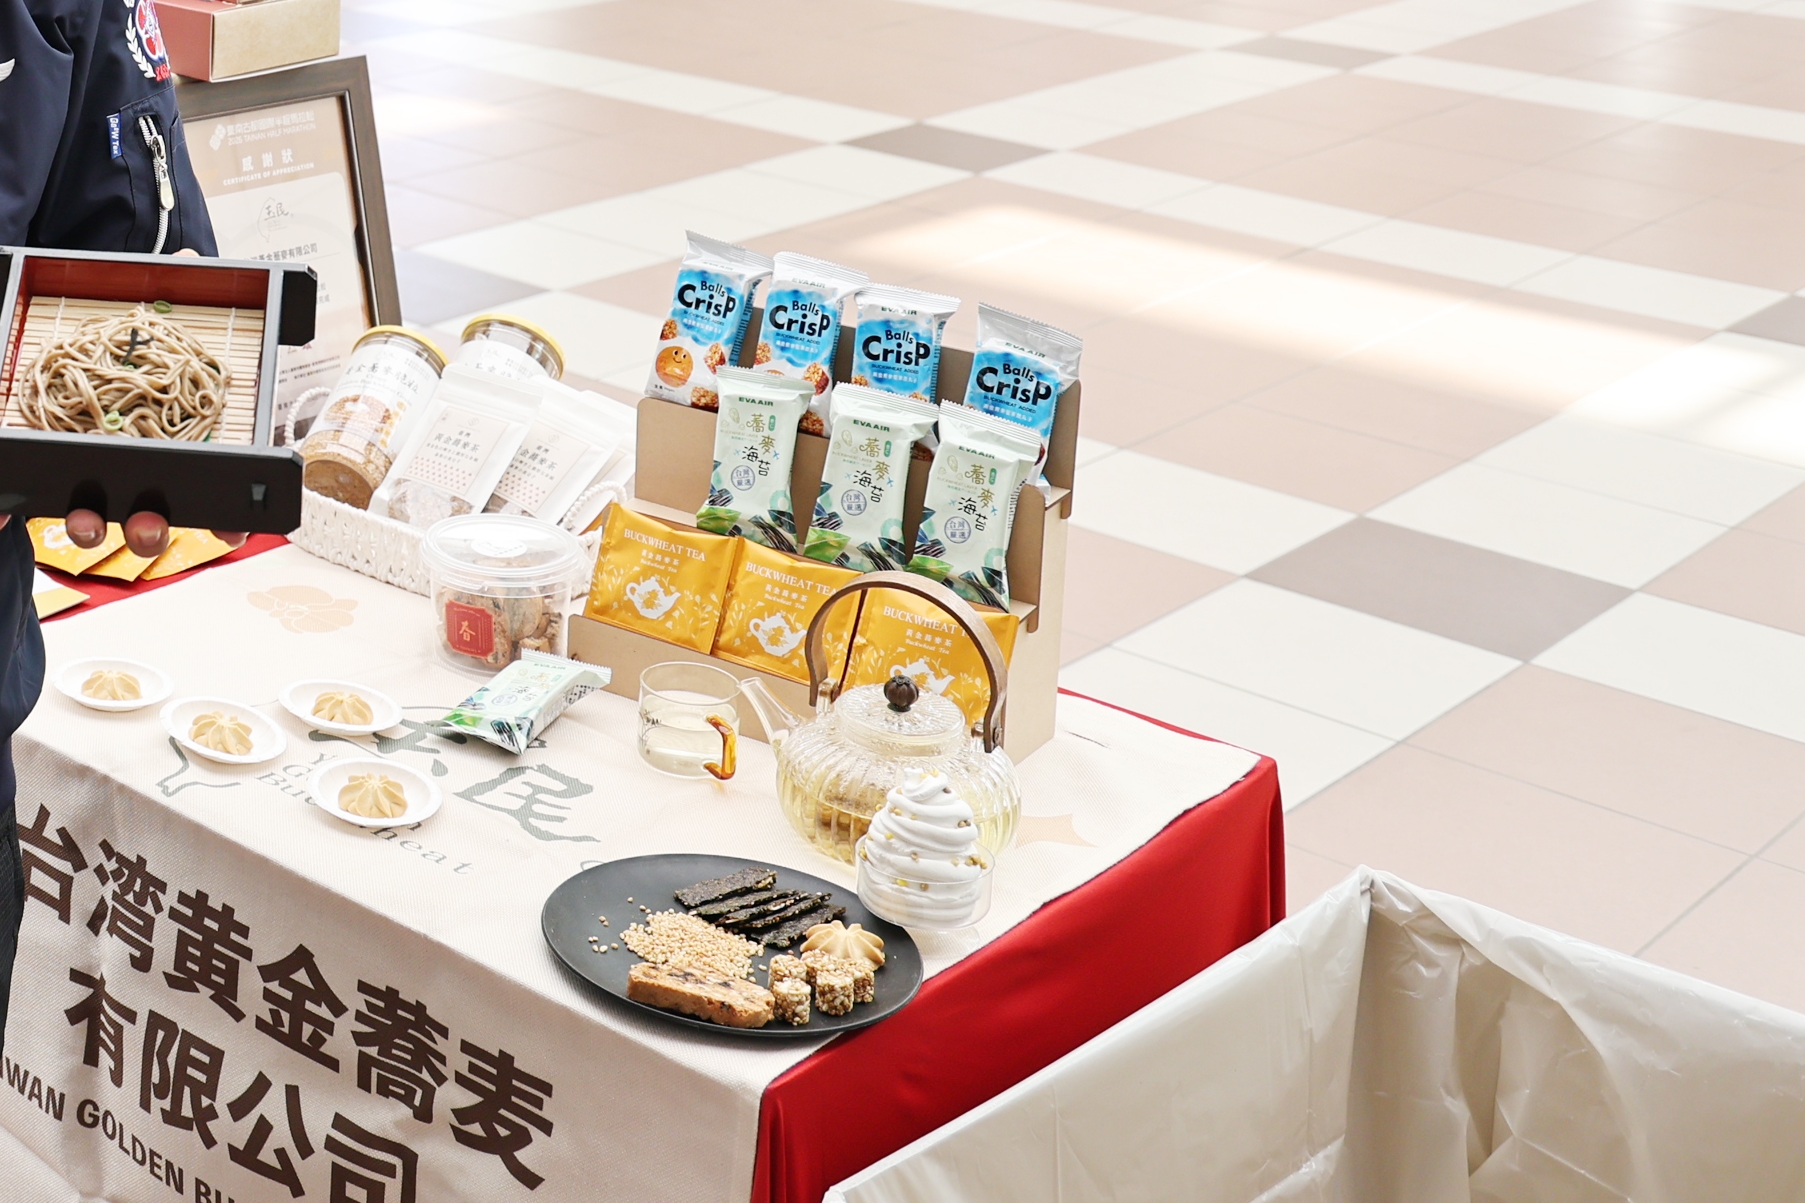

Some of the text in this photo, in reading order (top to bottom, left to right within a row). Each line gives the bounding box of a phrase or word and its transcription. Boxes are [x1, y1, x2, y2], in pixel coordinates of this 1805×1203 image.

[242, 148, 294, 172] 感謝狀
[223, 162, 315, 186] CERTIFICATE OF APPRECIATION
[700, 280, 726, 297] Balls
[792, 299, 820, 316] Balls
[885, 329, 914, 345] Balls
[871, 363, 902, 372] BUCKWHEAT
[1003, 363, 1035, 383] Balls
[984, 395, 1017, 408] BUCKWHEAT
[742, 445, 771, 477] 海苔
[853, 470, 884, 503] 海苔
[958, 497, 989, 532] 海苔
[623, 528, 706, 562] BUCKWHEAT TEA
[640, 558, 678, 574] Buckwheat Tea
[641, 549, 680, 566] 黃金蕎麥茶
[745, 562, 838, 597] BUCKWHEAT TEA
[764, 593, 805, 610] Buckwheat Tea
[765, 583, 809, 603] 黃金蕎麥茶
[883, 605, 959, 635] BUCKWHEAT
[460, 620, 476, 642] 春
[905, 629, 953, 648] 黃金蕎麥茶
[905, 638, 951, 655] Buckwheat Tea
[64, 964, 419, 1203] 有限公司
[76, 1098, 185, 1196] GOLDEN
